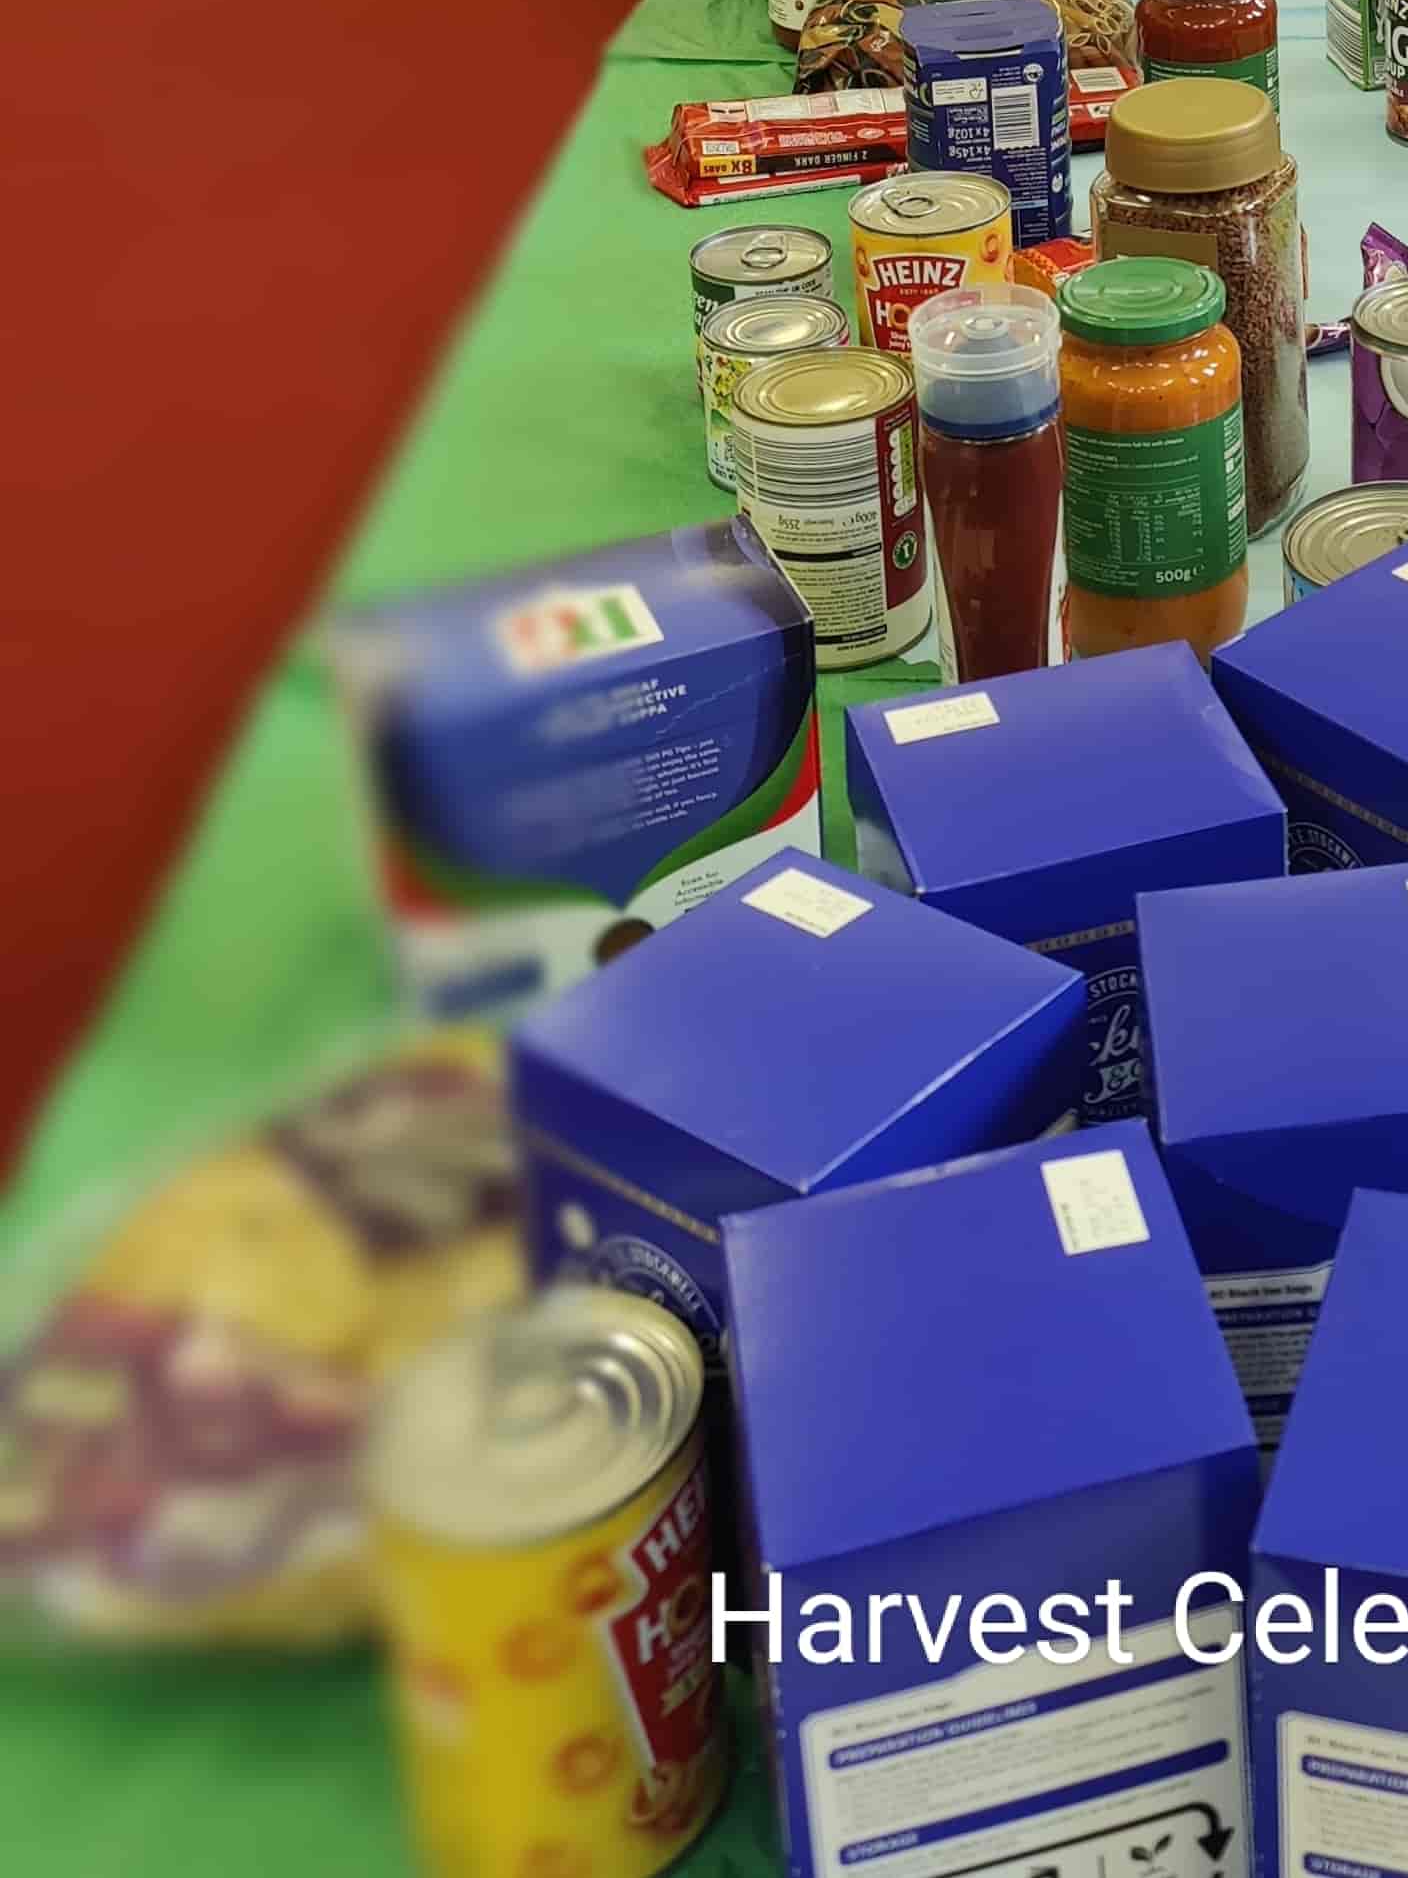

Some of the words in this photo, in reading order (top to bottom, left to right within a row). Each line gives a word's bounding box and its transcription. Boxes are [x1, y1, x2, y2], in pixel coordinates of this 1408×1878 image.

[794, 155, 823, 167] DARK
[825, 151, 860, 164] FINGER
[877, 259, 963, 288] HEINZ
[1155, 568, 1192, 584] 500g
